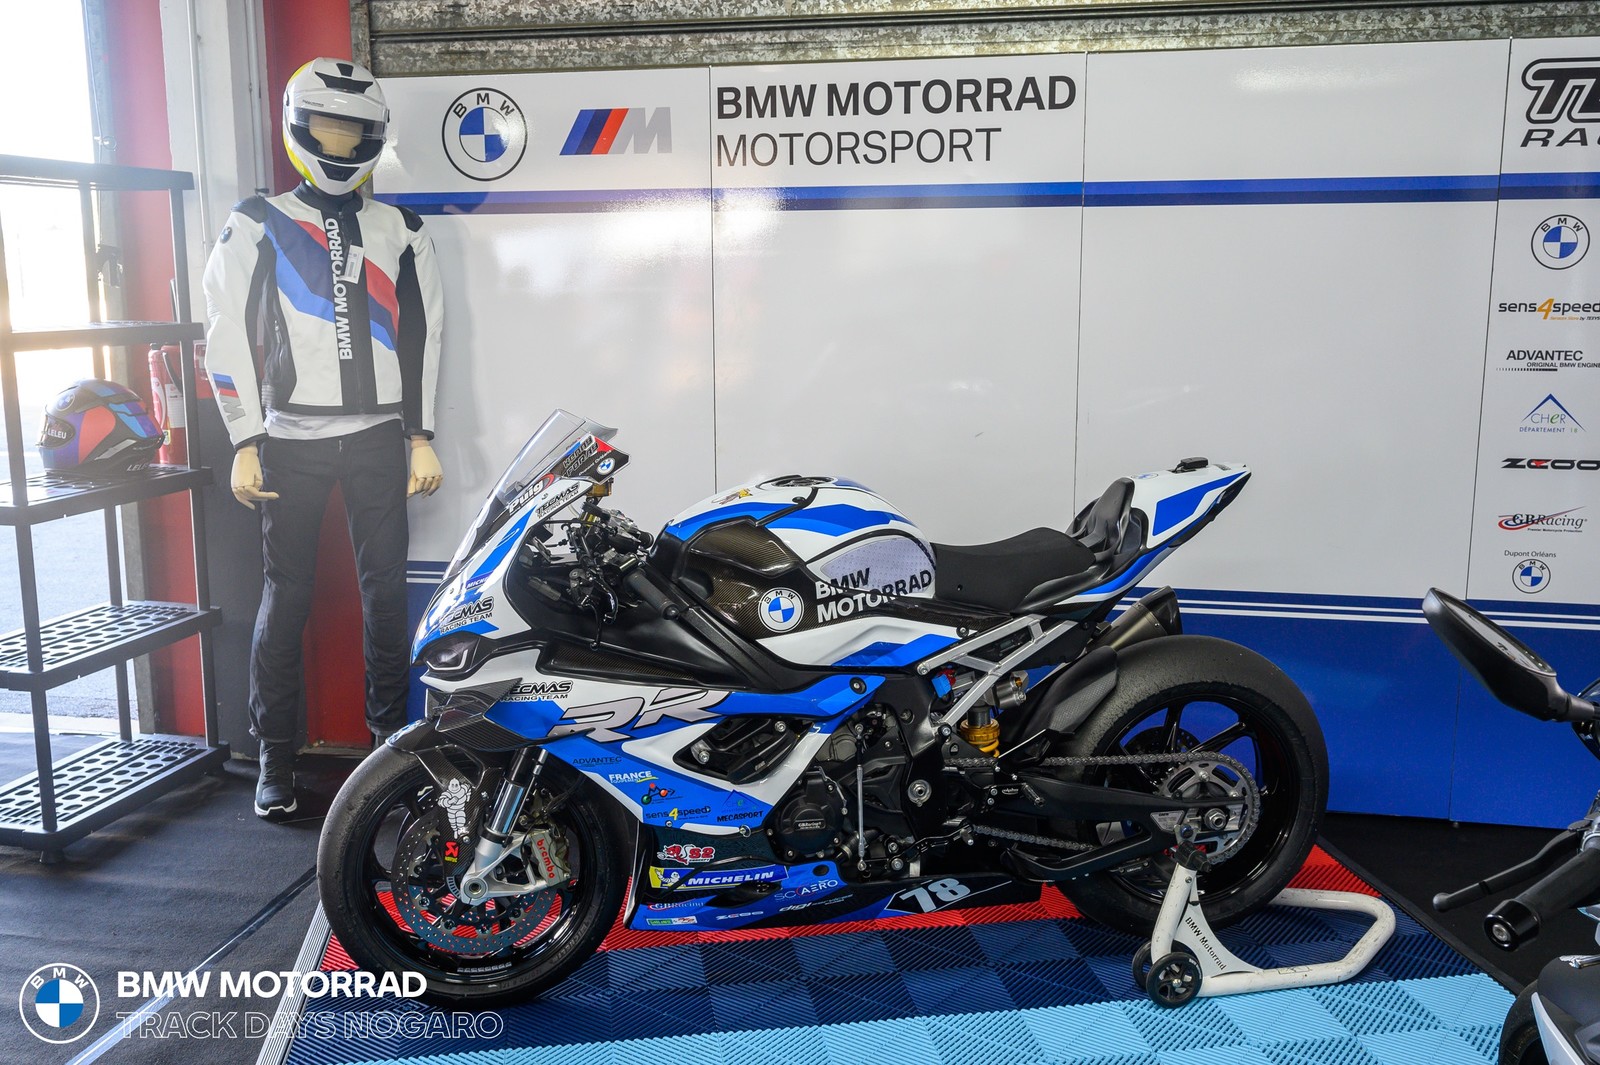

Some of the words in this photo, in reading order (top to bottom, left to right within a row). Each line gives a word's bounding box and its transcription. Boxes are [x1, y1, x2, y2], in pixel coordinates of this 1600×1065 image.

[452, 92, 515, 119] BMW
[717, 84, 818, 120] BMW
[827, 75, 1077, 118] MOTORRAD
[717, 127, 1002, 168] MOTORSPORT
[1519, 128, 1600, 148] RA
[1540, 216, 1584, 233] BMW
[325, 218, 348, 313] MOTORRAD
[335, 315, 353, 360] BMW
[1506, 350, 1583, 361] ADVANTEC
[47, 428, 67, 439] LELEU
[1519, 425, 1565, 433] DÉPARTEMENT
[509, 480, 544, 514] Puig
[1504, 550, 1530, 558] Dupont
[815, 567, 870, 600] BMW
[764, 590, 796, 605] BMW
[817, 569, 933, 624] MOTORRAD
[440, 620, 468, 634] RACING
[470, 612, 494, 623] TEAM
[508, 681, 573, 695] ECMAS
[572, 756, 622, 765] ADVANTEC
[608, 770, 653, 781] FRANCE
[645, 807, 709, 821] sens4speed
[717, 810, 764, 822] MECASPORT
[536, 838, 555, 880] brembo
[687, 871, 775, 885] MICHELIN
[899, 877, 971, 914] 78
[1185, 916, 1203, 937] BMW
[1200, 936, 1227, 971] Motorrad
